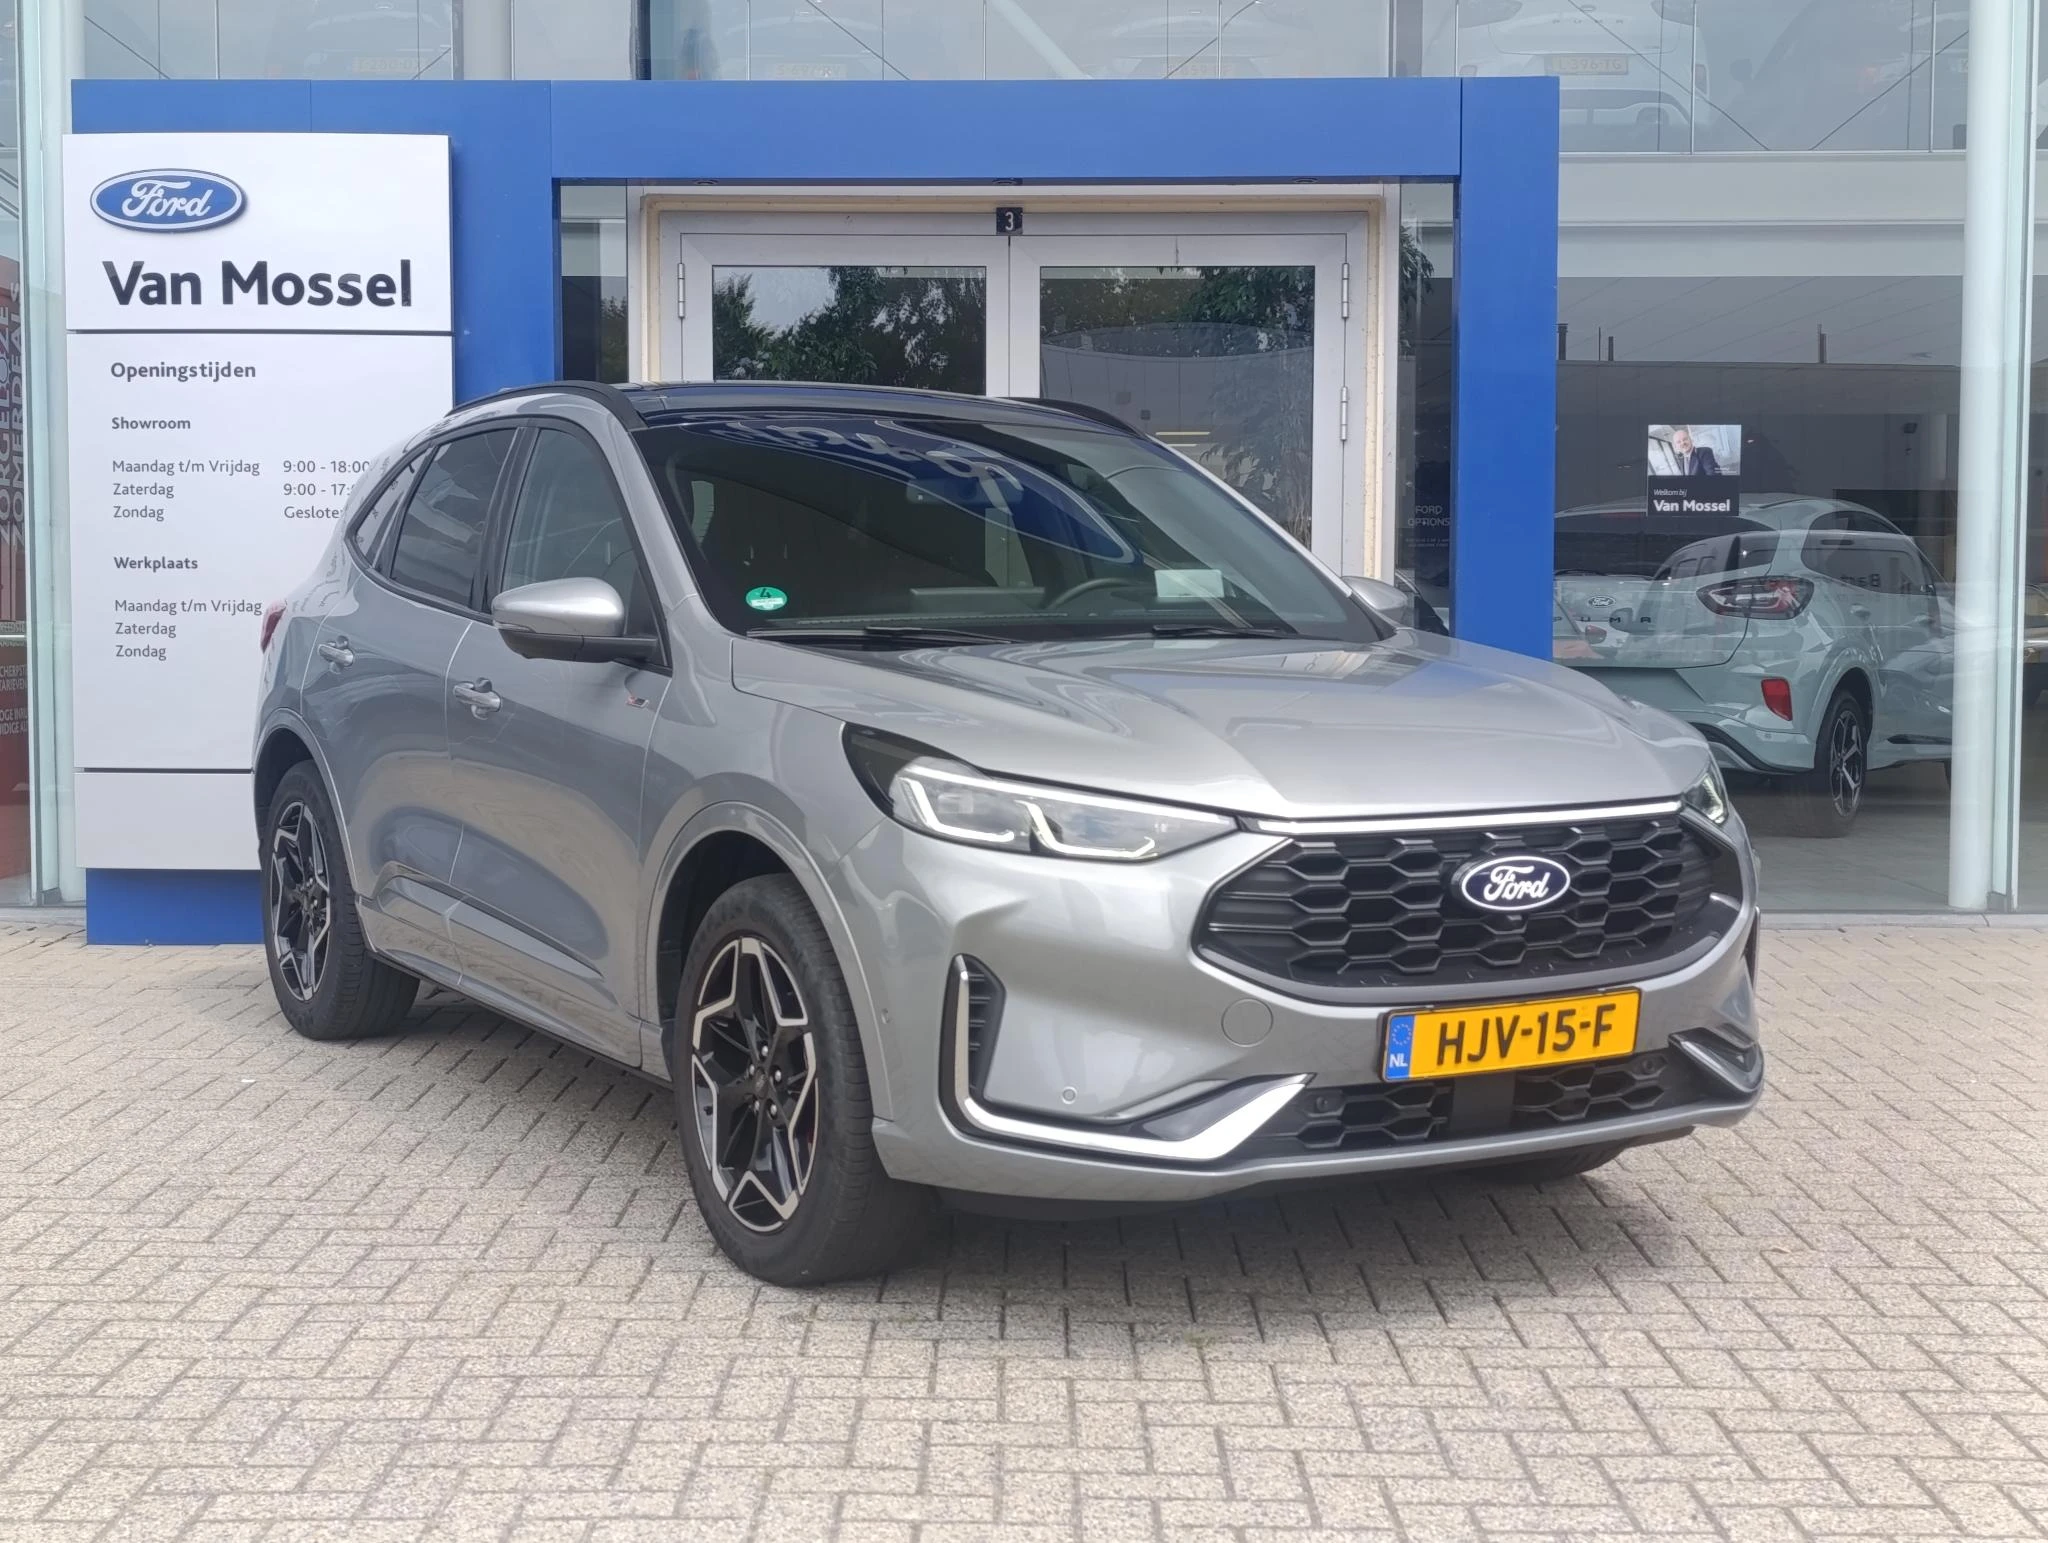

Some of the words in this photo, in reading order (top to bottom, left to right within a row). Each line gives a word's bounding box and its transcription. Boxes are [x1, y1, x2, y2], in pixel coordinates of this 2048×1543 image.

[121, 178, 214, 218] Ford
[1004, 211, 1016, 231] 3
[101, 259, 203, 306] Van
[221, 258, 413, 308] Mossel
[110, 361, 256, 382] Openingstijden
[111, 416, 191, 430] Showroom
[112, 459, 175, 477] Maandag
[178, 459, 205, 473] t/m
[209, 459, 261, 477] Vrijdag
[282, 459, 316, 473] 9:00
[112, 482, 175, 500] Zaterdag
[283, 482, 317, 496] 9:00
[330, 482, 354, 496] 17:
[1653, 488, 1678, 496] Welkom
[1679, 488, 1688, 497] bij
[112, 504, 165, 522] Zondag
[283, 505, 343, 519] Geslote
[1415, 505, 1444, 515] FORD
[1653, 499, 1680, 512] Van
[1682, 498, 1731, 512] Mossel
[1407, 517, 1451, 527] OPTIONS
[113, 556, 199, 574] Werkplaats
[759, 587, 772, 598] 4
[114, 599, 178, 617] Maandag
[180, 599, 207, 614] t/m
[210, 599, 263, 617] Vrijdag
[114, 621, 177, 639] Zaterdag
[115, 644, 167, 662] Zondag
[1482, 864, 1552, 902] Ford
[1436, 1004, 1617, 1065] HJV-15-F
[1388, 1051, 1408, 1068] NL
